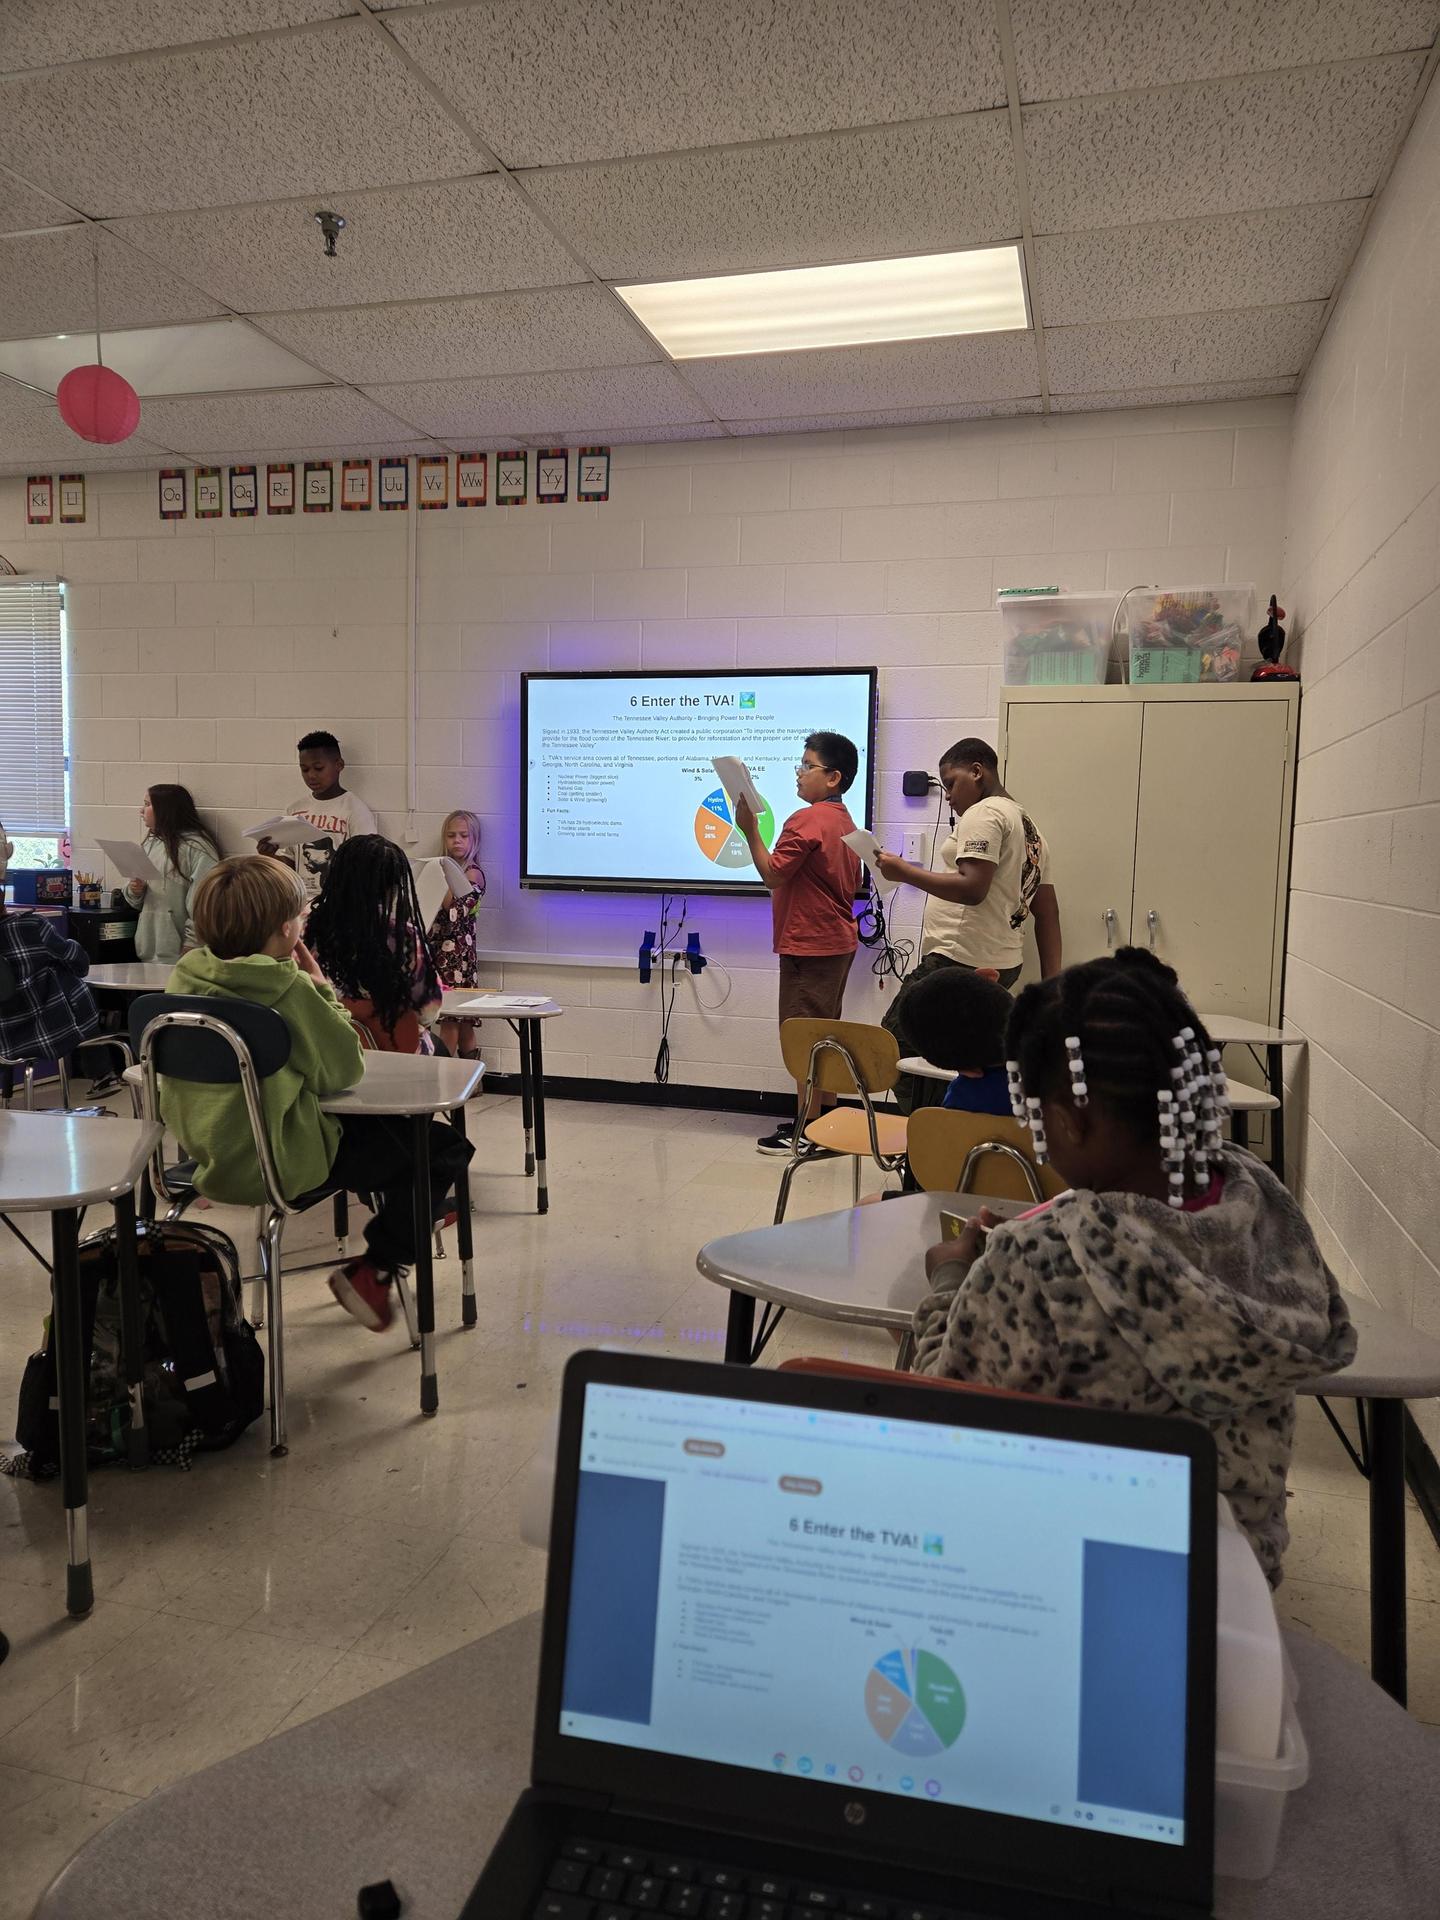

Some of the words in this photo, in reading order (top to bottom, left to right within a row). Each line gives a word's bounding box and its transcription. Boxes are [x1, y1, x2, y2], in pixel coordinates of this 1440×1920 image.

[461, 472, 482, 487] Ww
[502, 471, 522, 486] Xx
[542, 468, 562, 490] Yy
[585, 466, 602, 482] Zz
[272, 482, 288, 497] Rr
[310, 480, 326, 494] Ss
[348, 478, 366, 492] Tt
[384, 477, 403, 492] Uu
[424, 476, 442, 490] Vv
[32, 493, 47, 507] Kk
[163, 488, 181, 502] Oo
[200, 487, 216, 503] Pp
[234, 484, 254, 502] Qq
[630, 695, 638, 706] 6
[642, 695, 676, 706] Enter
[680, 695, 700, 706] the
[704, 695, 734, 706] TVA!
[789, 1518, 798, 1532] 6
[803, 1520, 846, 1538] Enter
[850, 1526, 875, 1542] the
[880, 1530, 920, 1549] TVA!
